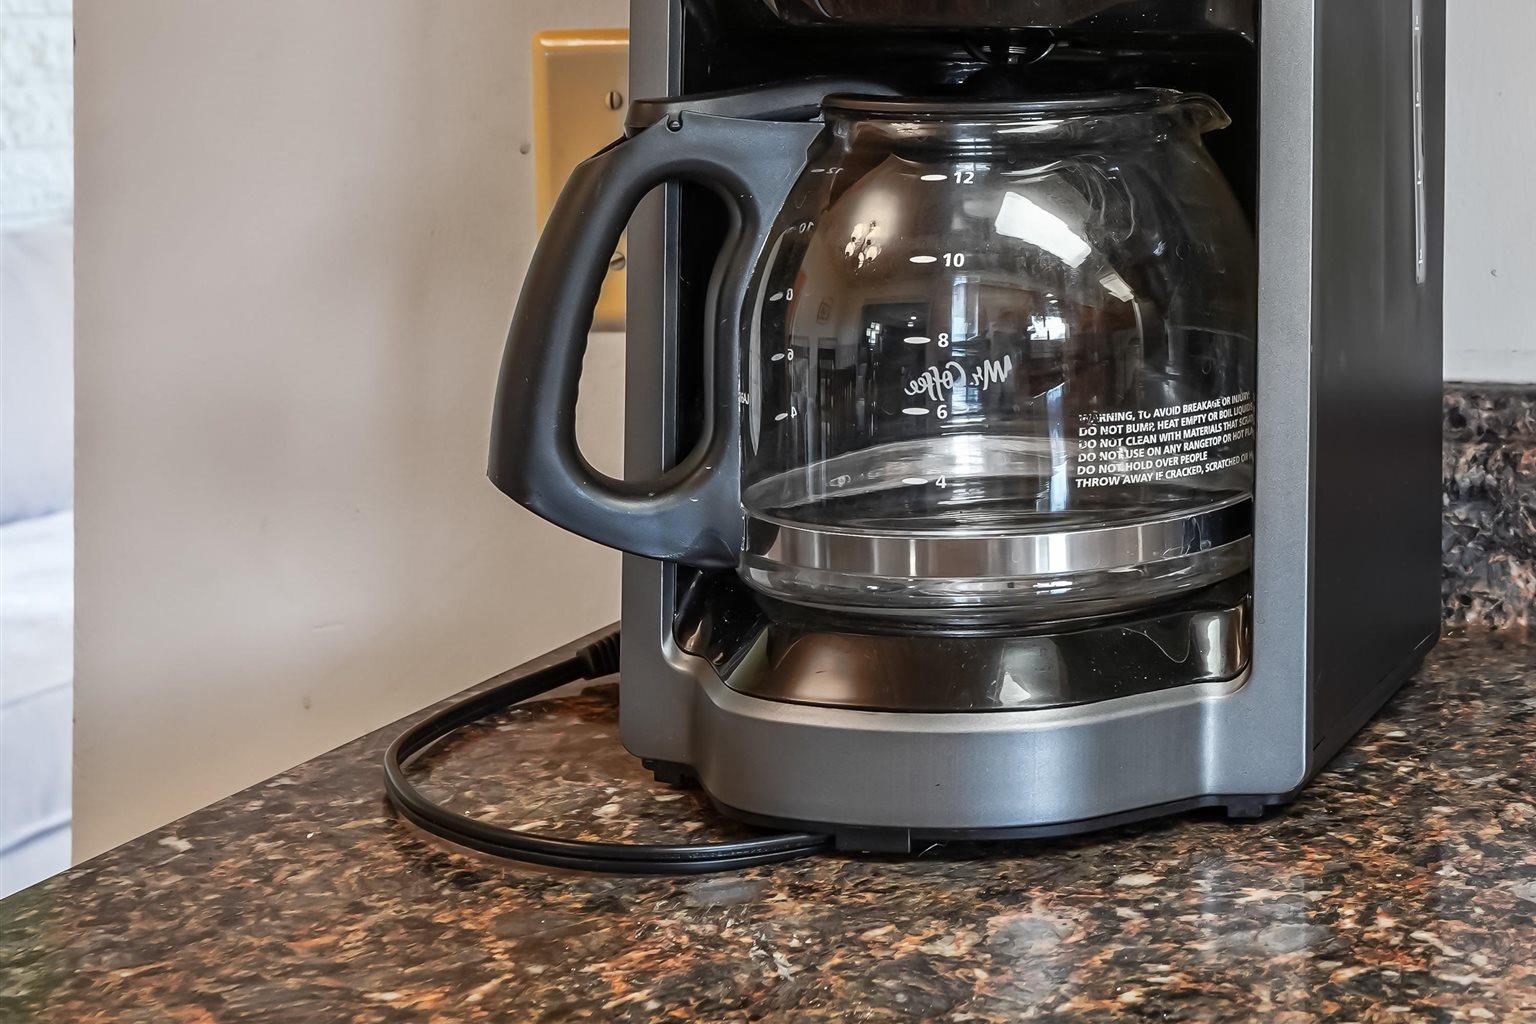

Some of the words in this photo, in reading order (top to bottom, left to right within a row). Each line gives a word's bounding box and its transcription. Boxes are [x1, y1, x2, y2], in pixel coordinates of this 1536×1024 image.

[953, 171, 975, 184] 12
[943, 252, 966, 268] 10
[937, 332, 950, 348] 8
[936, 404, 948, 419] 6
[1153, 405, 1181, 418] AVOID
[1182, 398, 1221, 414] BREAKAGE
[1221, 396, 1231, 406] OR
[1078, 426, 1098, 437] DO
[1100, 424, 1124, 436] NOT
[1125, 422, 1155, 435] BUMP,
[1157, 418, 1180, 431] HEAT
[1181, 413, 1207, 427] EMPTY
[1207, 411, 1218, 422] OR
[1219, 407, 1233, 420] BOIL
[1078, 439, 1097, 450] DO
[1099, 437, 1124, 448] NOT
[1125, 433, 1158, 446] CLEAN
[1158, 430, 1182, 443] WITH
[1182, 422, 1223, 439] MATERIALS
[1223, 418, 1239, 431] THAT
[1077, 452, 1097, 463] DO
[1125, 448, 1145, 458] USE
[1146, 446, 1162, 456] ON
[1163, 443, 1182, 455] ANY
[1183, 435, 1222, 451] RANGETOP
[1222, 433, 1232, 444] OR
[1232, 429, 1245, 441] HOT
[1075, 476, 1120, 488] THROW
[1122, 472, 1154, 485] AWAY
[1155, 471, 1164, 481] IF
[1165, 465, 1204, 479] CRACKED,
[1205, 456, 1240, 473] SCRATCHED
[1076, 465, 1096, 476] DO
[1125, 460, 1154, 472] HOLD
[1155, 456, 1179, 468] OVER
[1180, 451, 1208, 465] PEOPLE
[935, 475, 947, 489] 4
